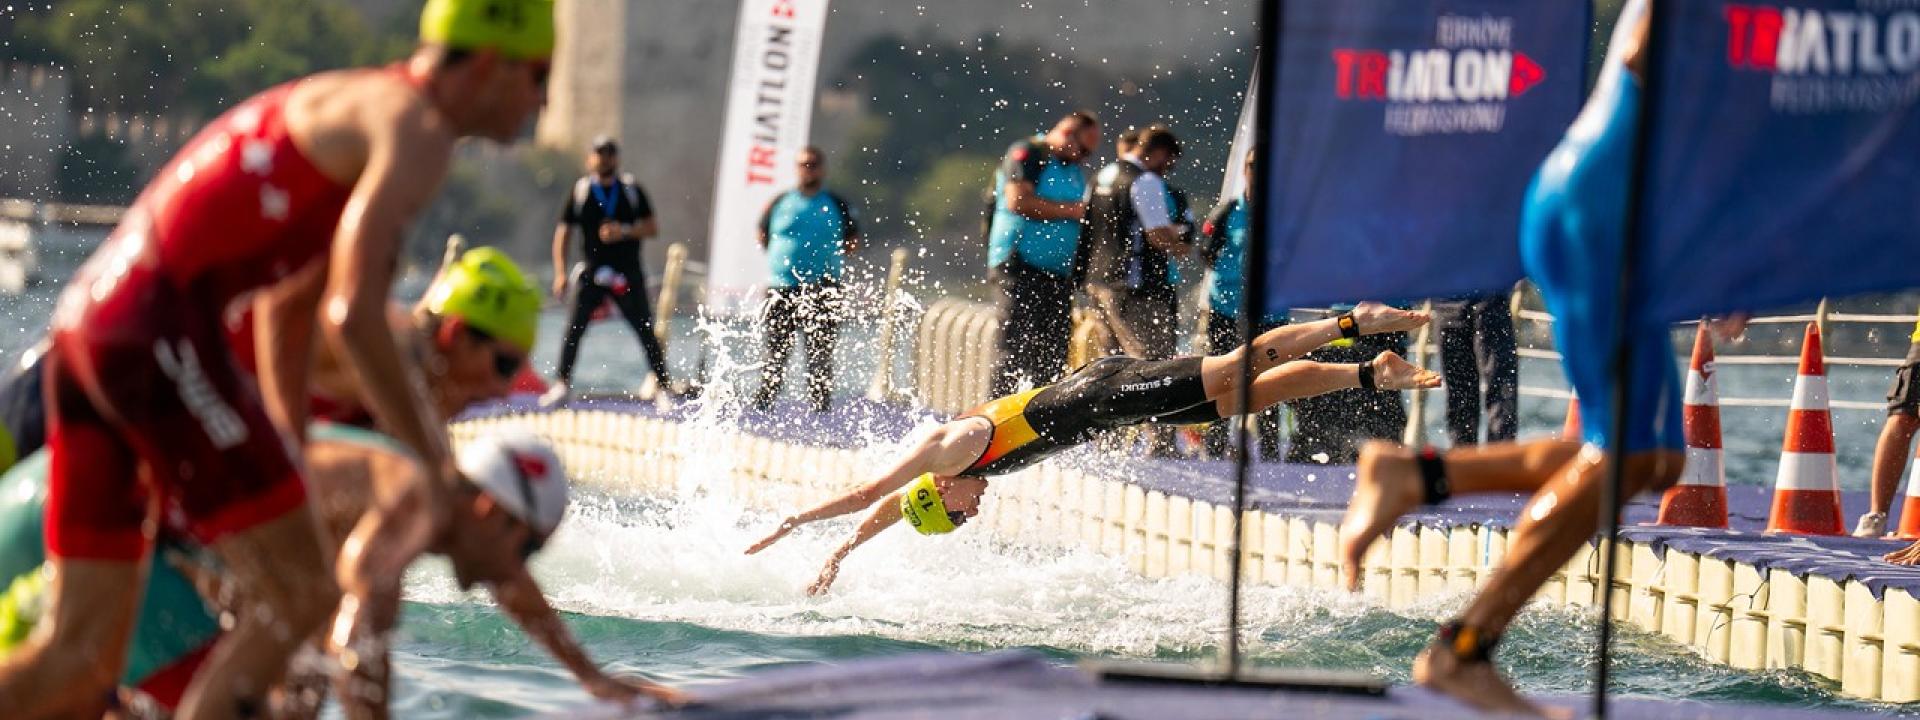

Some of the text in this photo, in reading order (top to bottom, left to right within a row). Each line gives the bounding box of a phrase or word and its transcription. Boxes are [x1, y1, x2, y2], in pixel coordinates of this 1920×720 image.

[1724, 6, 1920, 75] TRiATLO
[1121, 380, 1161, 392] SUZUKI
[917, 488, 933, 512] 19
